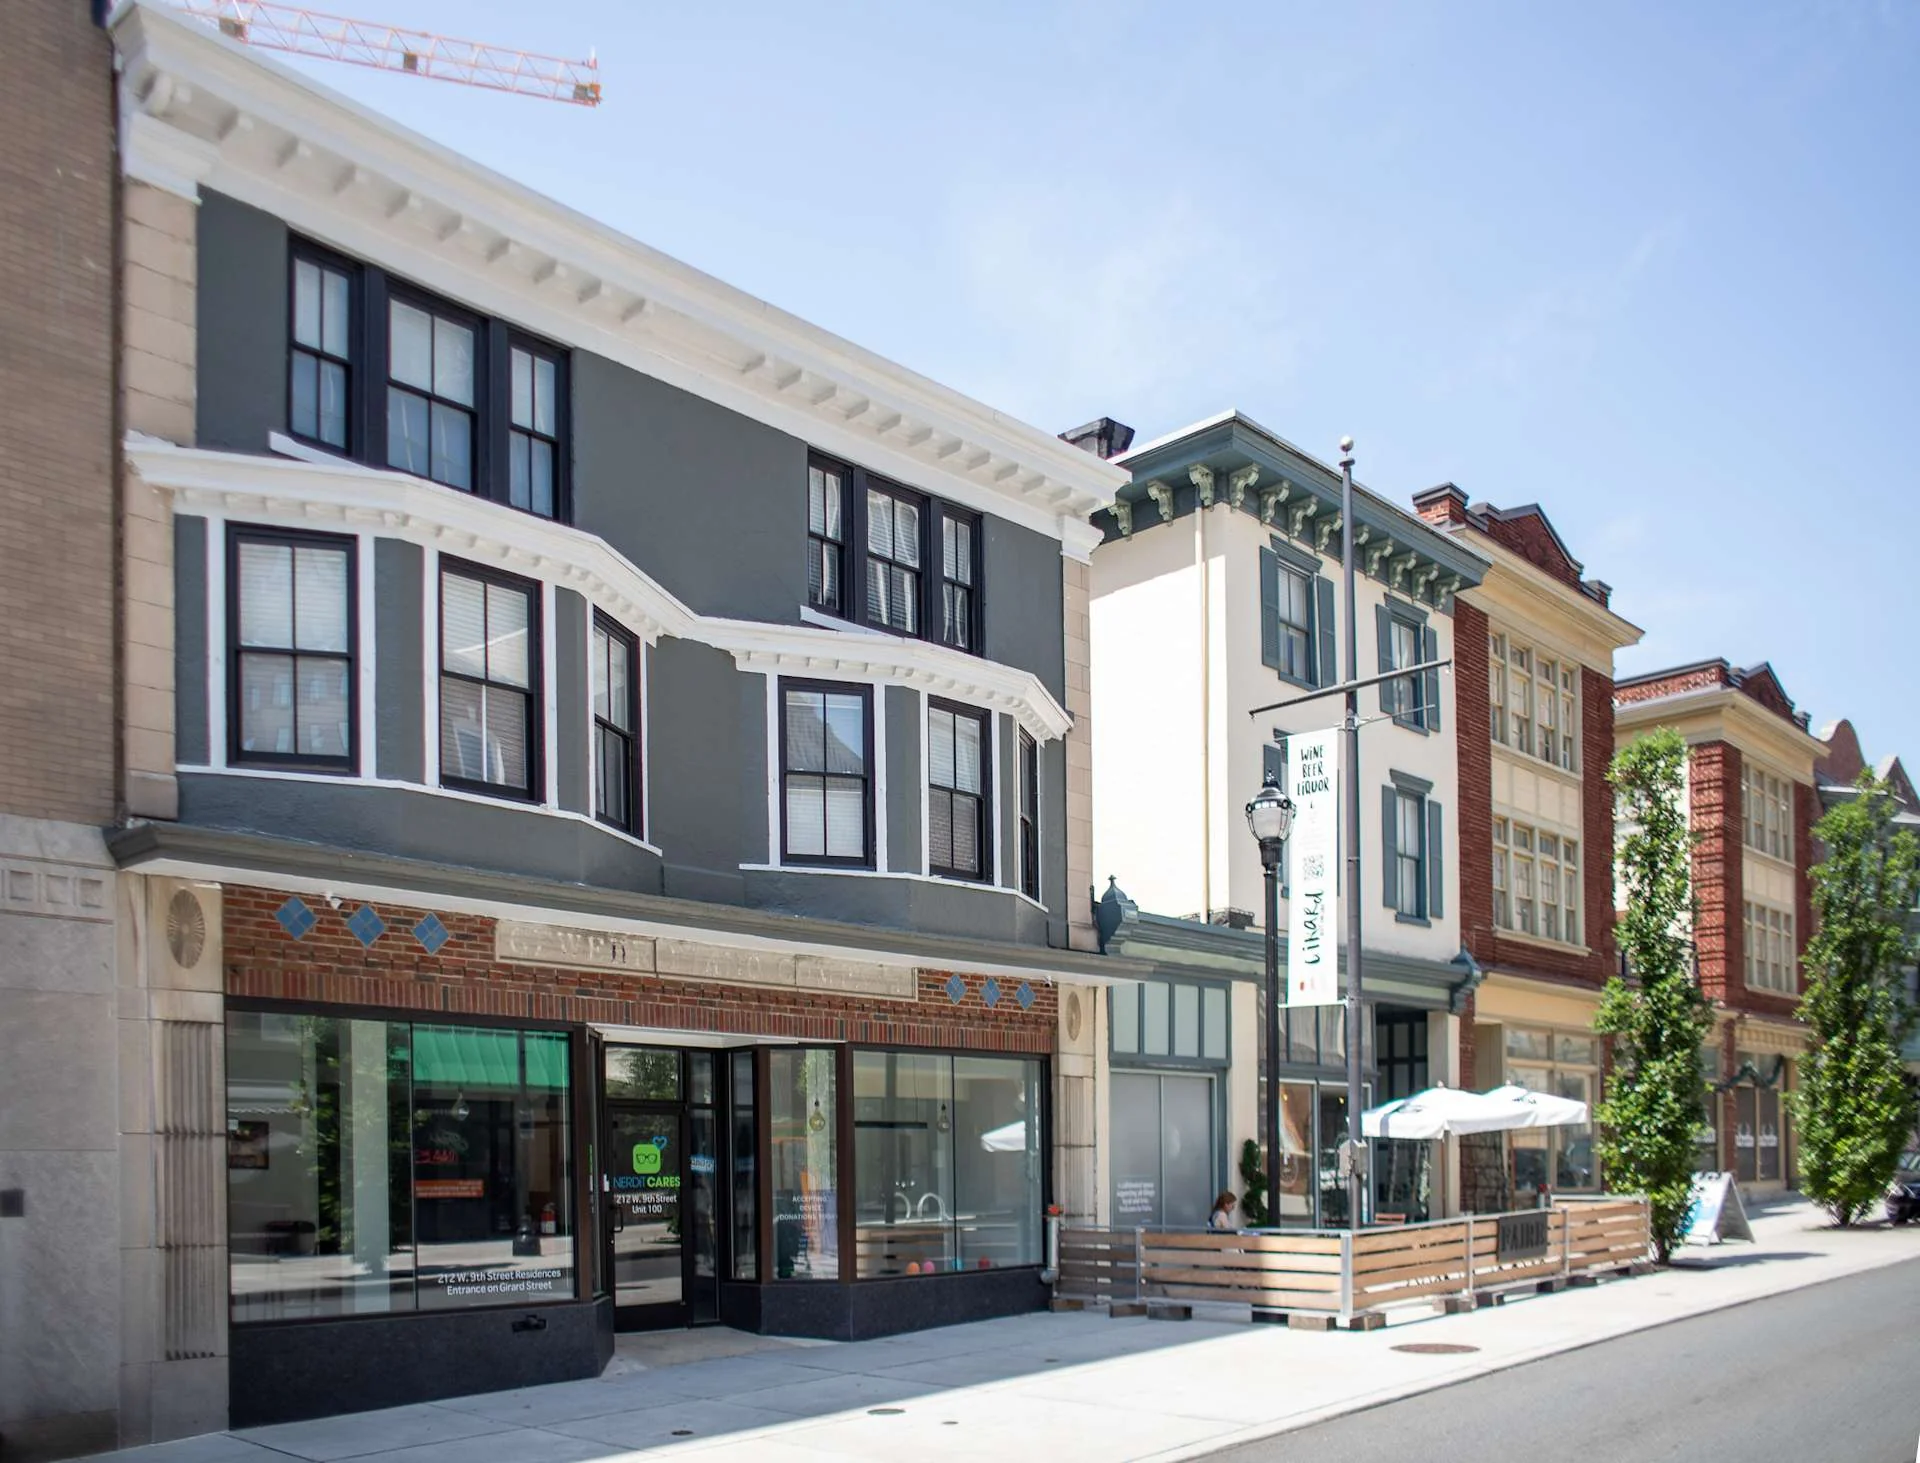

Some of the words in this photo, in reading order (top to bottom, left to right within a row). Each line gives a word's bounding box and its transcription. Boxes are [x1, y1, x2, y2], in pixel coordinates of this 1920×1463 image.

[1302, 760, 1324, 778] BEER
[646, 1176, 681, 1188] CARES
[616, 1194, 631, 1205] 212
[631, 1193, 642, 1204] W.
[642, 1192, 655, 1204] 9th
[655, 1192, 677, 1204] Street
[632, 1204, 647, 1215] Unit
[648, 1204, 663, 1214] 100
[438, 1273, 455, 1284] 212
[456, 1272, 469, 1283] W.
[470, 1271, 486, 1283] 9th
[487, 1270, 515, 1282] Street
[515, 1269, 562, 1280] Residences
[447, 1284, 486, 1296] Entrance
[487, 1284, 499, 1292] on
[499, 1281, 525, 1293] Girard
[526, 1280, 553, 1291] Street
